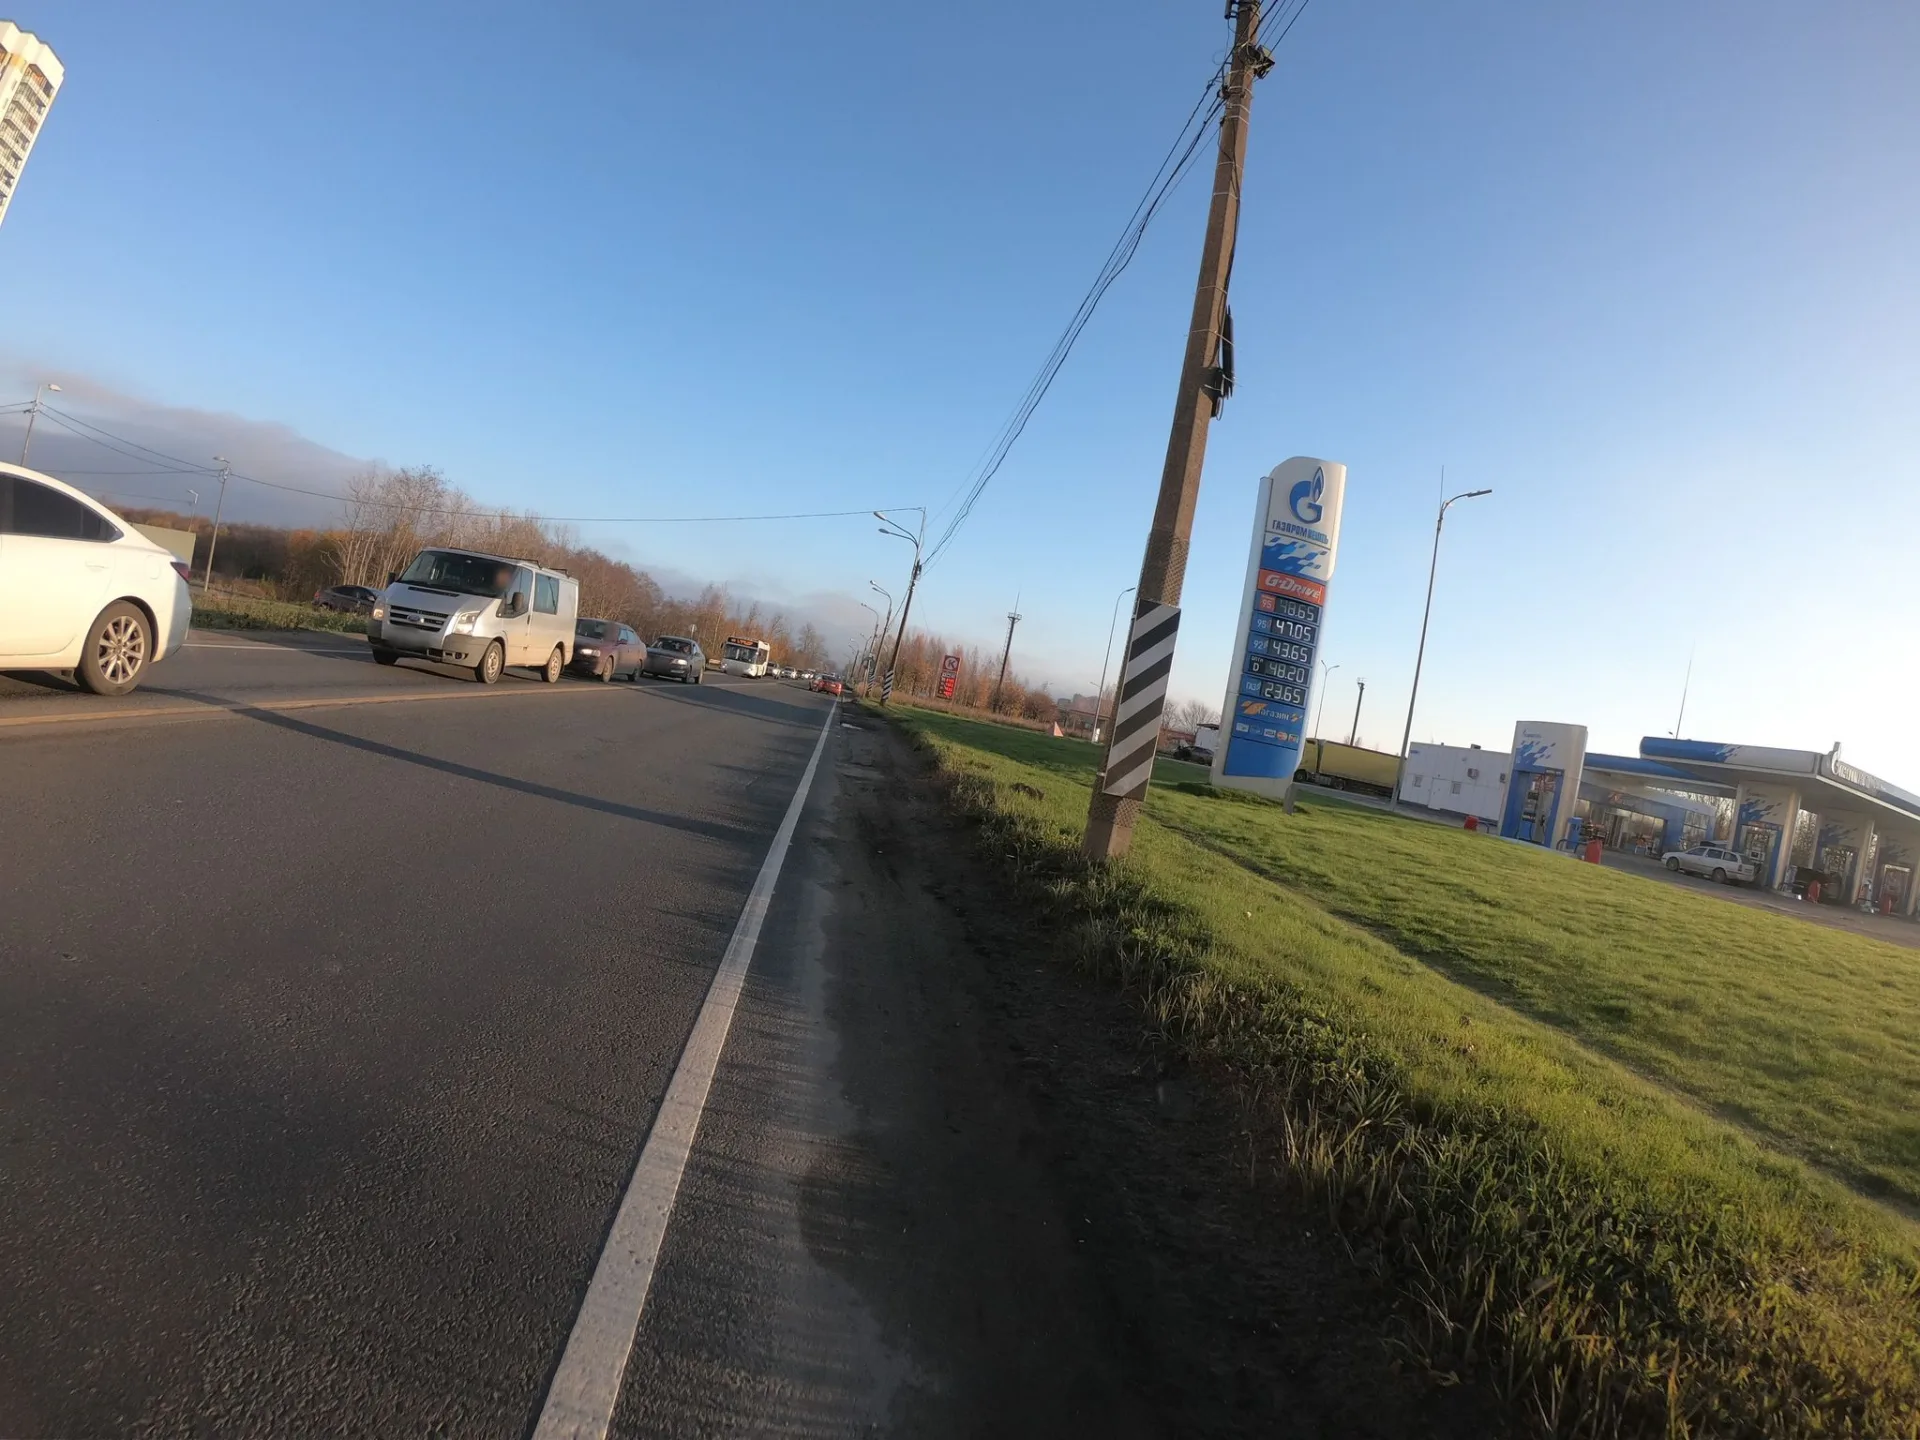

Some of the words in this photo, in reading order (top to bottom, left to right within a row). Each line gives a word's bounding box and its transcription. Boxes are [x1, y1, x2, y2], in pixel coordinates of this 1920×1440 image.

[1262, 599, 1272, 610] 95
[1280, 600, 1315, 621] 48.65
[1257, 620, 1267, 631] 95
[1276, 619, 1312, 642] 47.05
[1253, 640, 1264, 650] 92
[1273, 641, 1308, 663] 43.65
[1252, 662, 1260, 672] D
[1269, 662, 1305, 683] 48.20
[1264, 682, 1301, 704] 23.65
